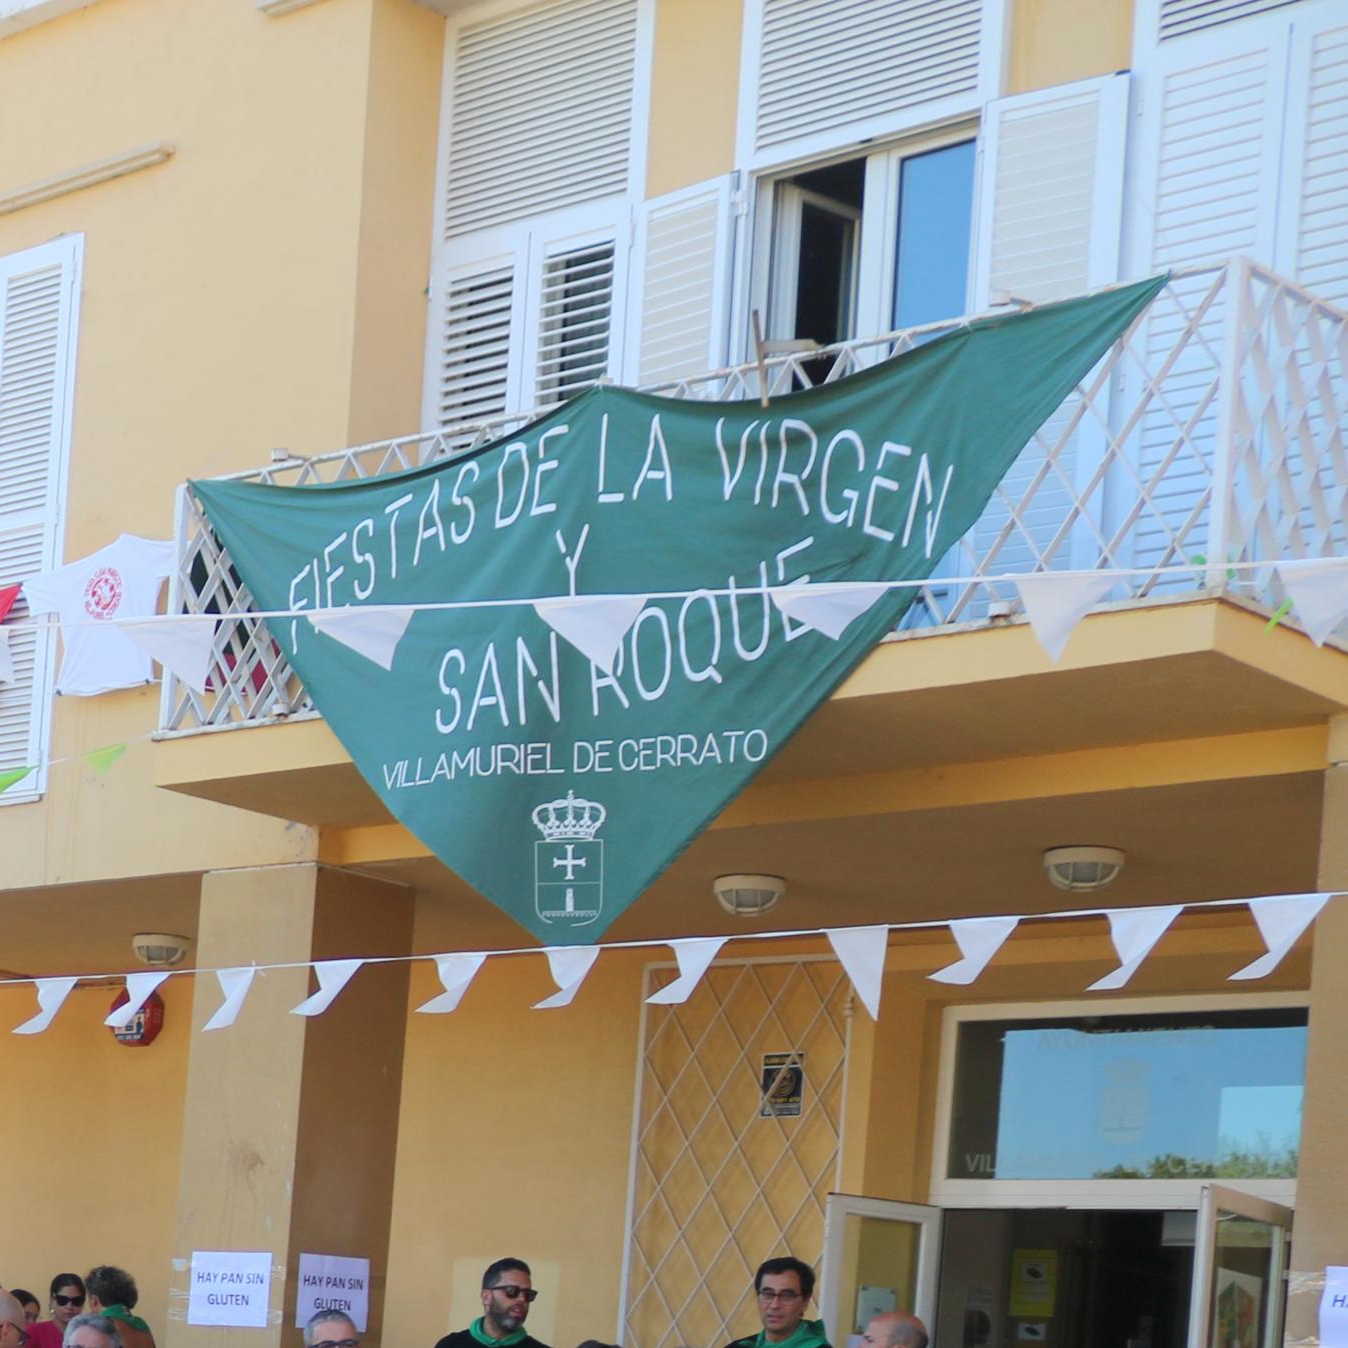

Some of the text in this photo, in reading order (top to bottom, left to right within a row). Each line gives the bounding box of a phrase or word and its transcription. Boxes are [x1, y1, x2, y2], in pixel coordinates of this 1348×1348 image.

[288, 412, 954, 655] FIESTAS DE LA VIRGEN
[555, 522, 590, 597] Y
[435, 536, 815, 735] SAN ROQUE
[382, 728, 768, 791] VILLAMURIEL DE CERRATO
[197, 1272, 265, 1284] HAY PAN SIN
[303, 1275, 364, 1290] HAY PAN SIN
[207, 1293, 249, 1306] GLUTEN
[313, 1297, 352, 1311] GLUTEN
